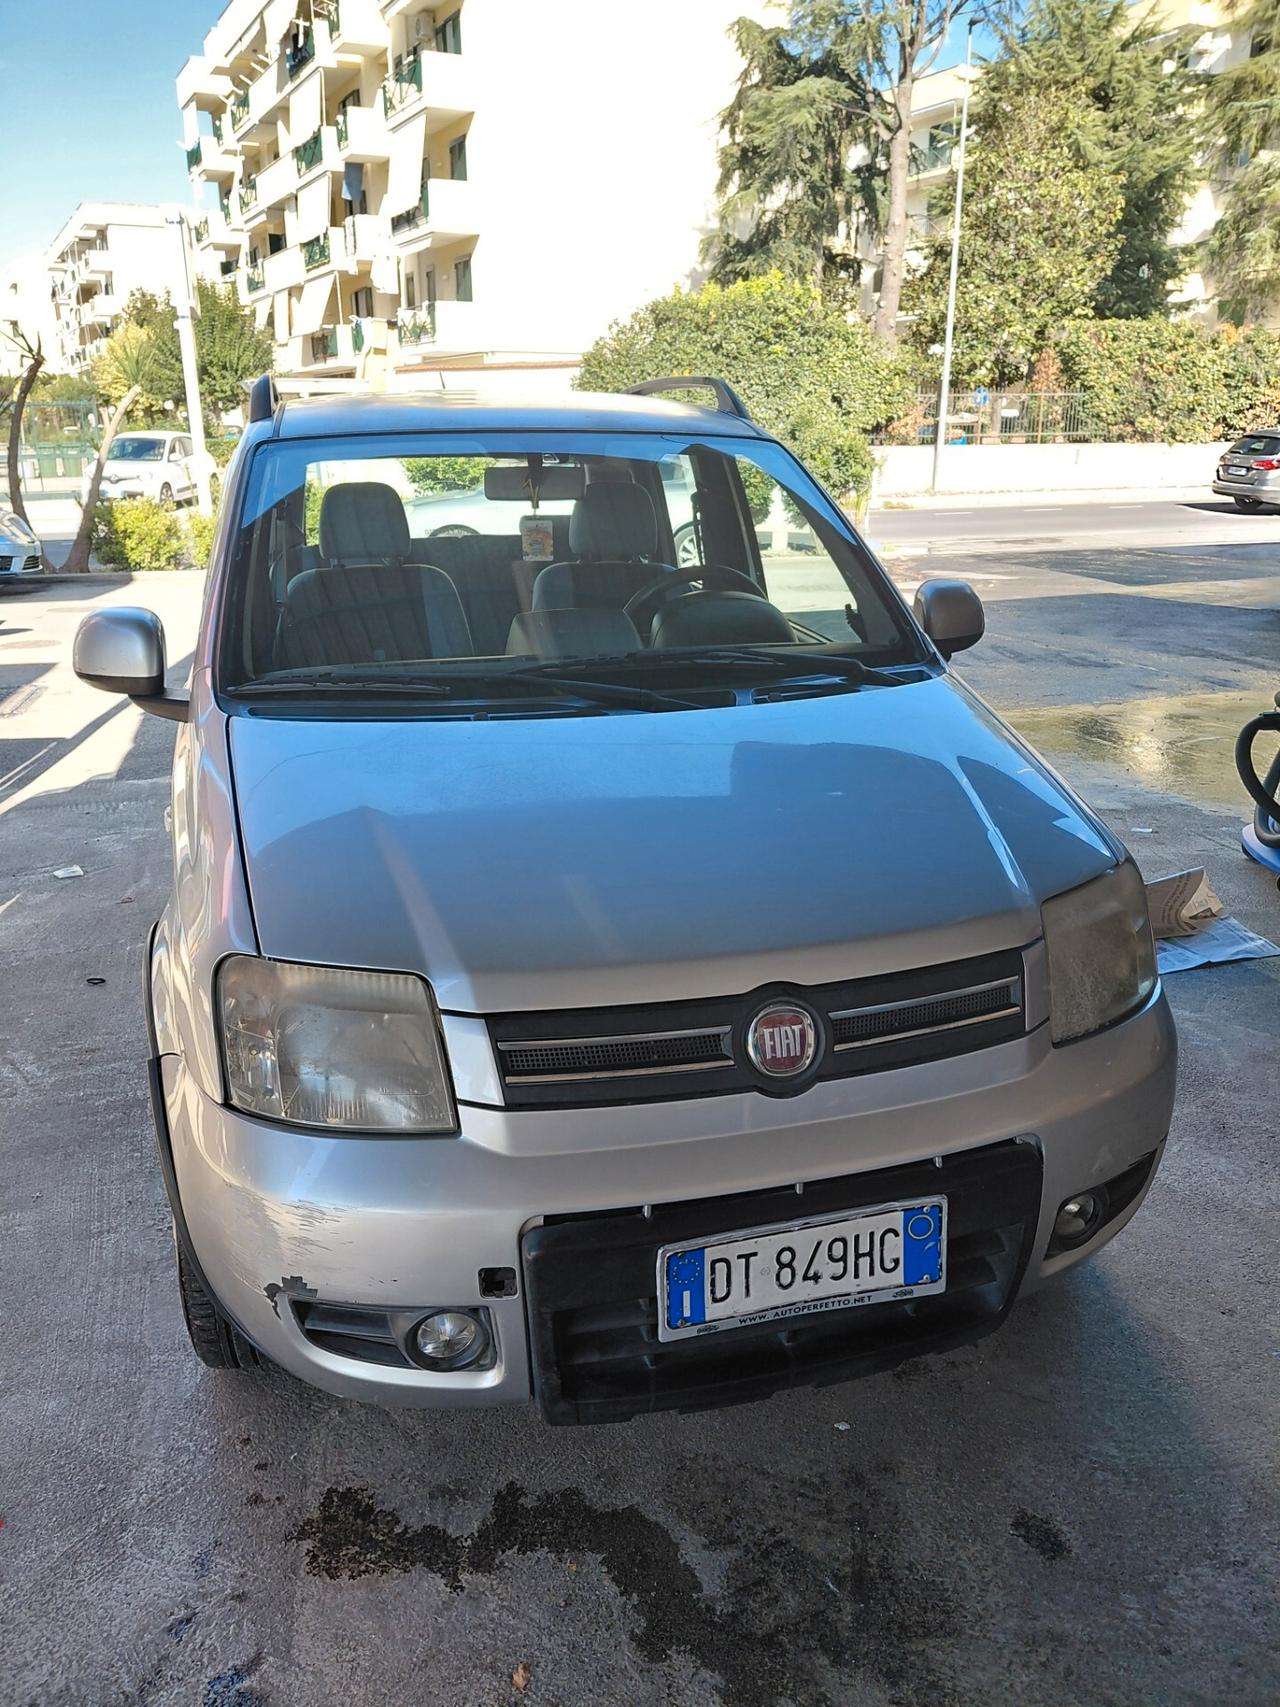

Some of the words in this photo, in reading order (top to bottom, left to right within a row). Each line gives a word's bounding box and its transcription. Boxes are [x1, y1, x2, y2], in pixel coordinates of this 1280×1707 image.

[763, 1024, 803, 1060] FIAT
[709, 1252, 760, 1305] DT
[775, 1227, 900, 1291] 849HG
